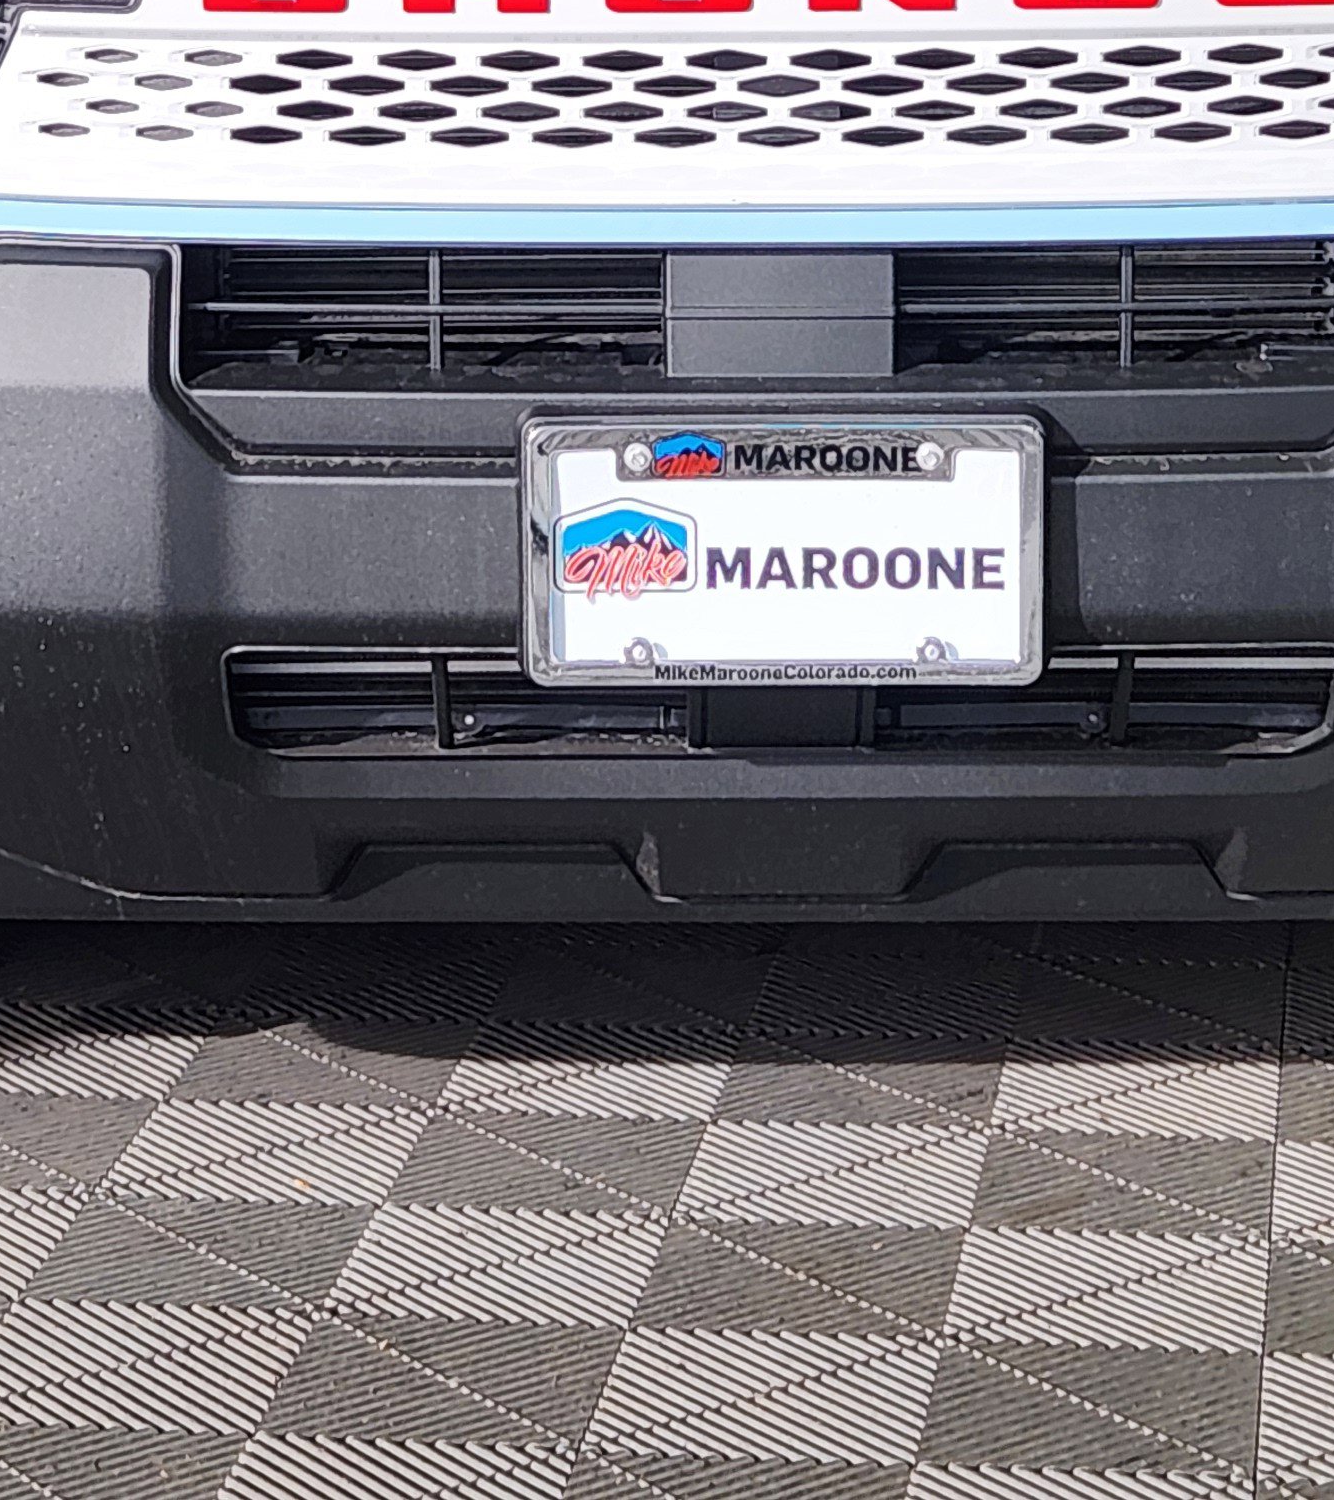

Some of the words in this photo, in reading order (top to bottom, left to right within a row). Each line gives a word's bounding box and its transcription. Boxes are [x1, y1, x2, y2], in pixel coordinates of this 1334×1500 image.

[733, 443, 923, 473] MAROONE
[564, 541, 687, 604] Mike
[705, 546, 1006, 591] MAROONE
[653, 663, 918, 682] MikeMarooneColorado.com
